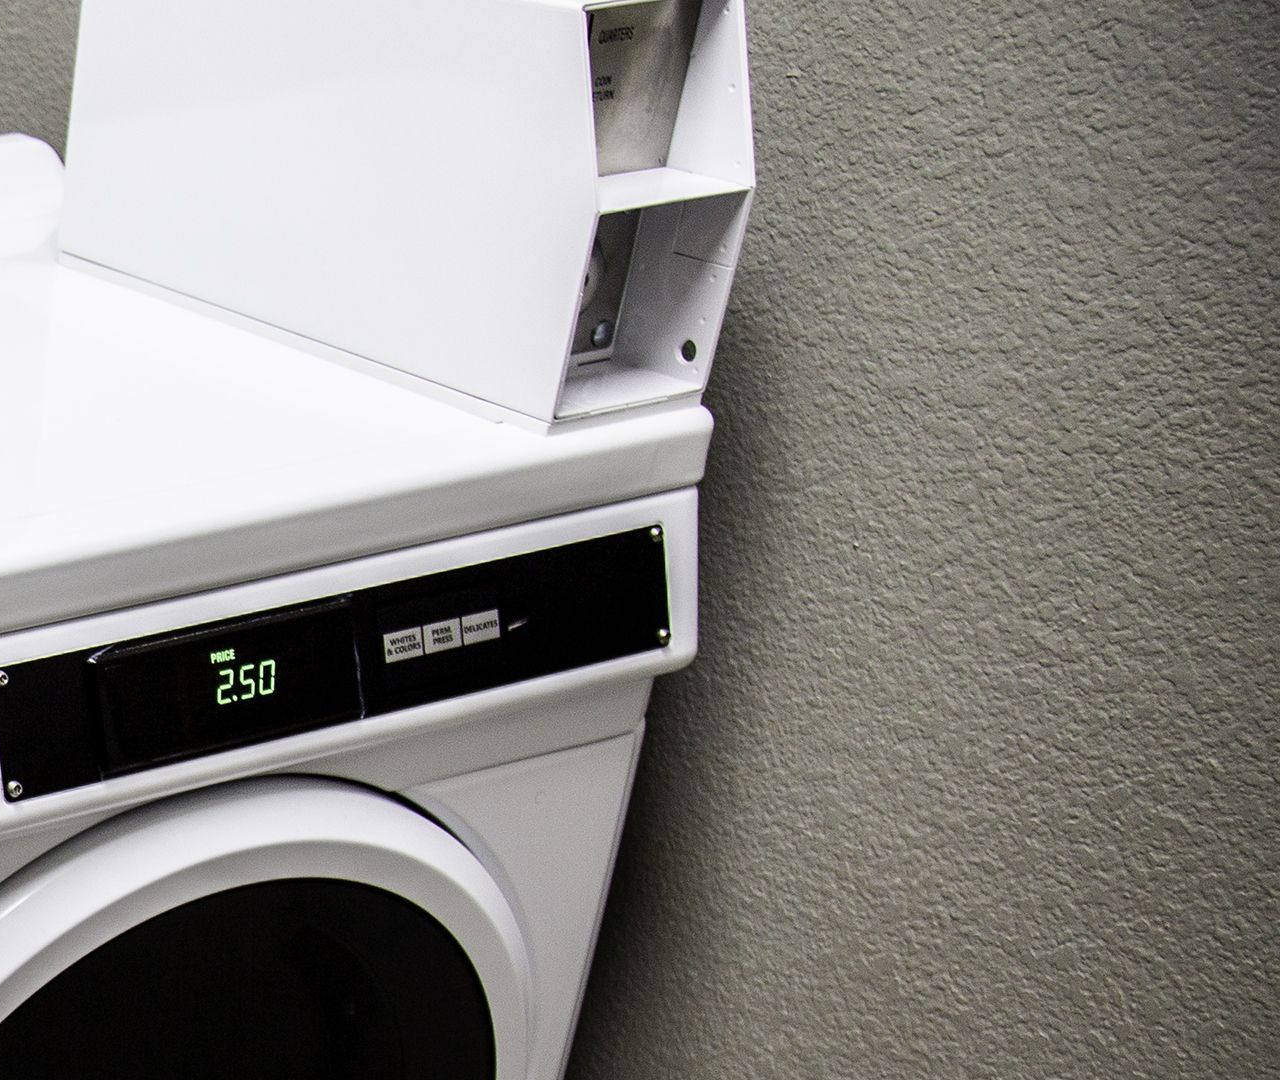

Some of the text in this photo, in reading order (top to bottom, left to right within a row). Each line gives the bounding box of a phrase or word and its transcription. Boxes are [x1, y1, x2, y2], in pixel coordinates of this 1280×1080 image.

[464, 620, 498, 634] DELICATES
[390, 635, 416, 646] WHITES
[433, 635, 453, 645] PRESS
[394, 642, 421, 655] COLORS
[210, 648, 236, 664] PRICE
[217, 659, 276, 705] 2.50
